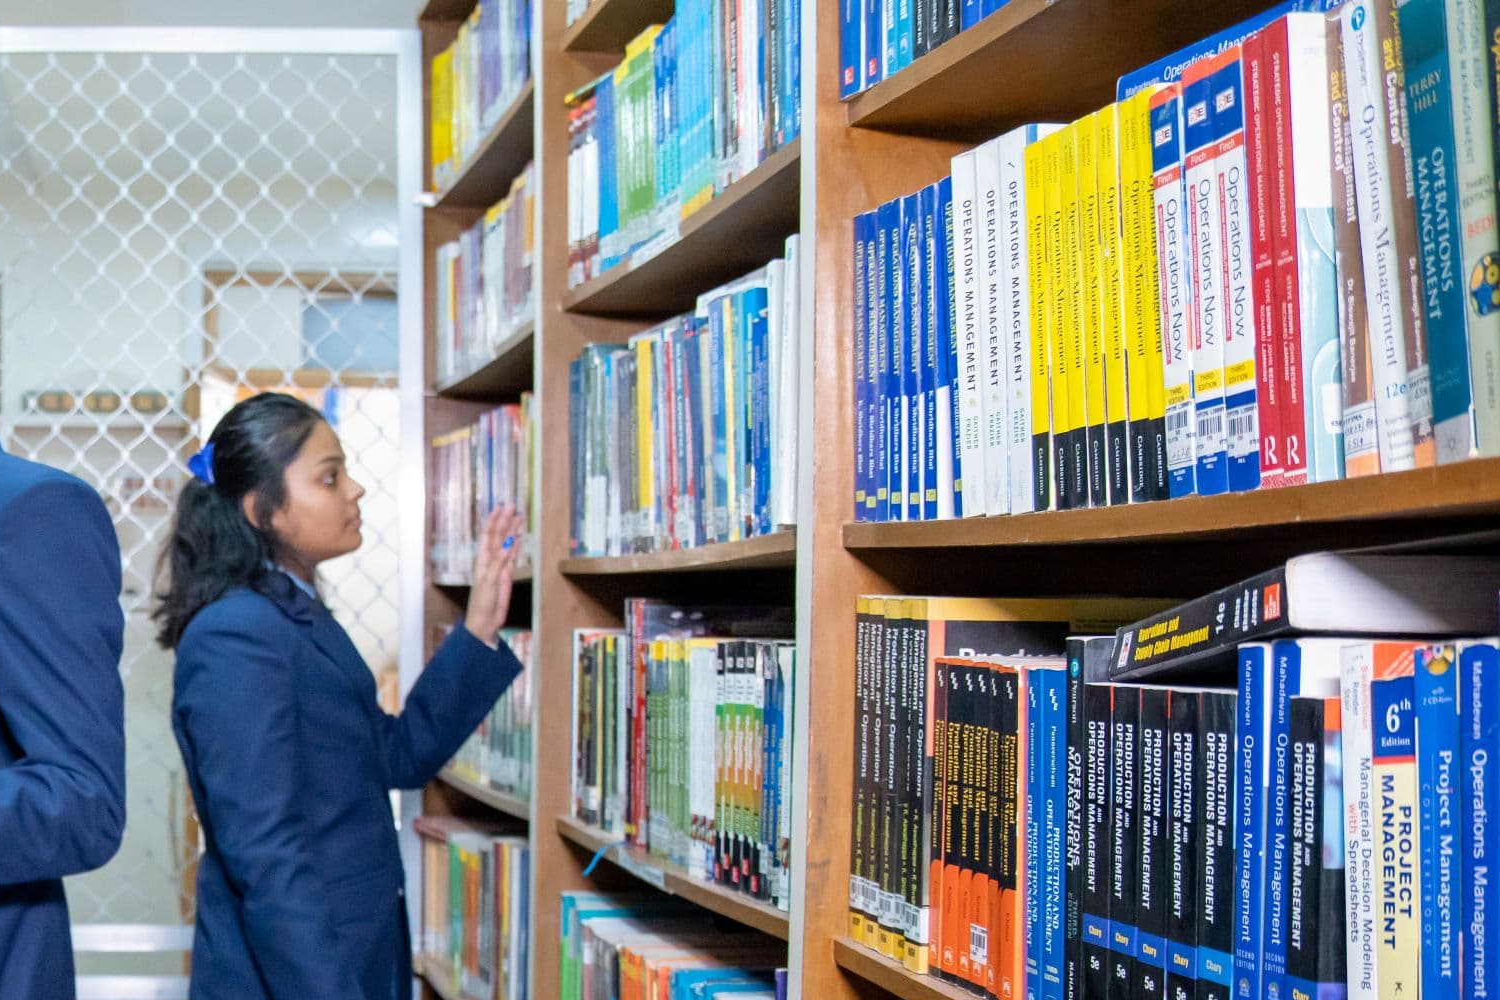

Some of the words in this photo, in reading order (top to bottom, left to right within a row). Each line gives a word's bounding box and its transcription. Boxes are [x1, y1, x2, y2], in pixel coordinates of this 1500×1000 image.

[1409, 70, 1441, 98] TERRY
[1191, 152, 1206, 164] Finch
[1009, 181, 1018, 271] OPERATIONS
[1132, 180, 1140, 261] Operations
[1166, 199, 1180, 308] Operations
[1360, 104, 1381, 224] Operations
[1375, 227, 1397, 366] Management
[1418, 157, 1441, 320] MANAGEMENT
[1431, 147, 1453, 292] OPERATIONS
[1011, 276, 1022, 383] MANAGEMENT
[1135, 265, 1143, 357] Management
[1172, 312, 1182, 361] Now
[1138, 621, 1167, 642] Operations
[1168, 616, 1179, 632] and
[1154, 639, 1170, 655] Chain
[1171, 626, 1209, 651] Management
[1216, 603, 1225, 634] 14e
[1381, 736, 1411, 748] Edition
[1386, 699, 1411, 733] 6th
[1097, 722, 1105, 805] PRODUCTION
[1243, 734, 1254, 826] Operations
[1358, 757, 1371, 847] Managerial
[1437, 750, 1453, 827] Project
[1073, 753, 1081, 867] OPERATIONS
[1087, 803, 1096, 893] MANAGEMENT
[1349, 804, 1357, 833] with
[1242, 832, 1252, 942] Management
[1348, 840, 1359, 944] Spreadsheets
[1360, 849, 1372, 914] Decision
[1381, 775, 1396, 950] MANAGEMENT
[1399, 806, 1412, 919] PROJECT
[1438, 834, 1453, 977] Management
[1090, 956, 1099, 970] 5e
[1361, 919, 1373, 991] Modeling
[1395, 982, 1402, 996] K.
